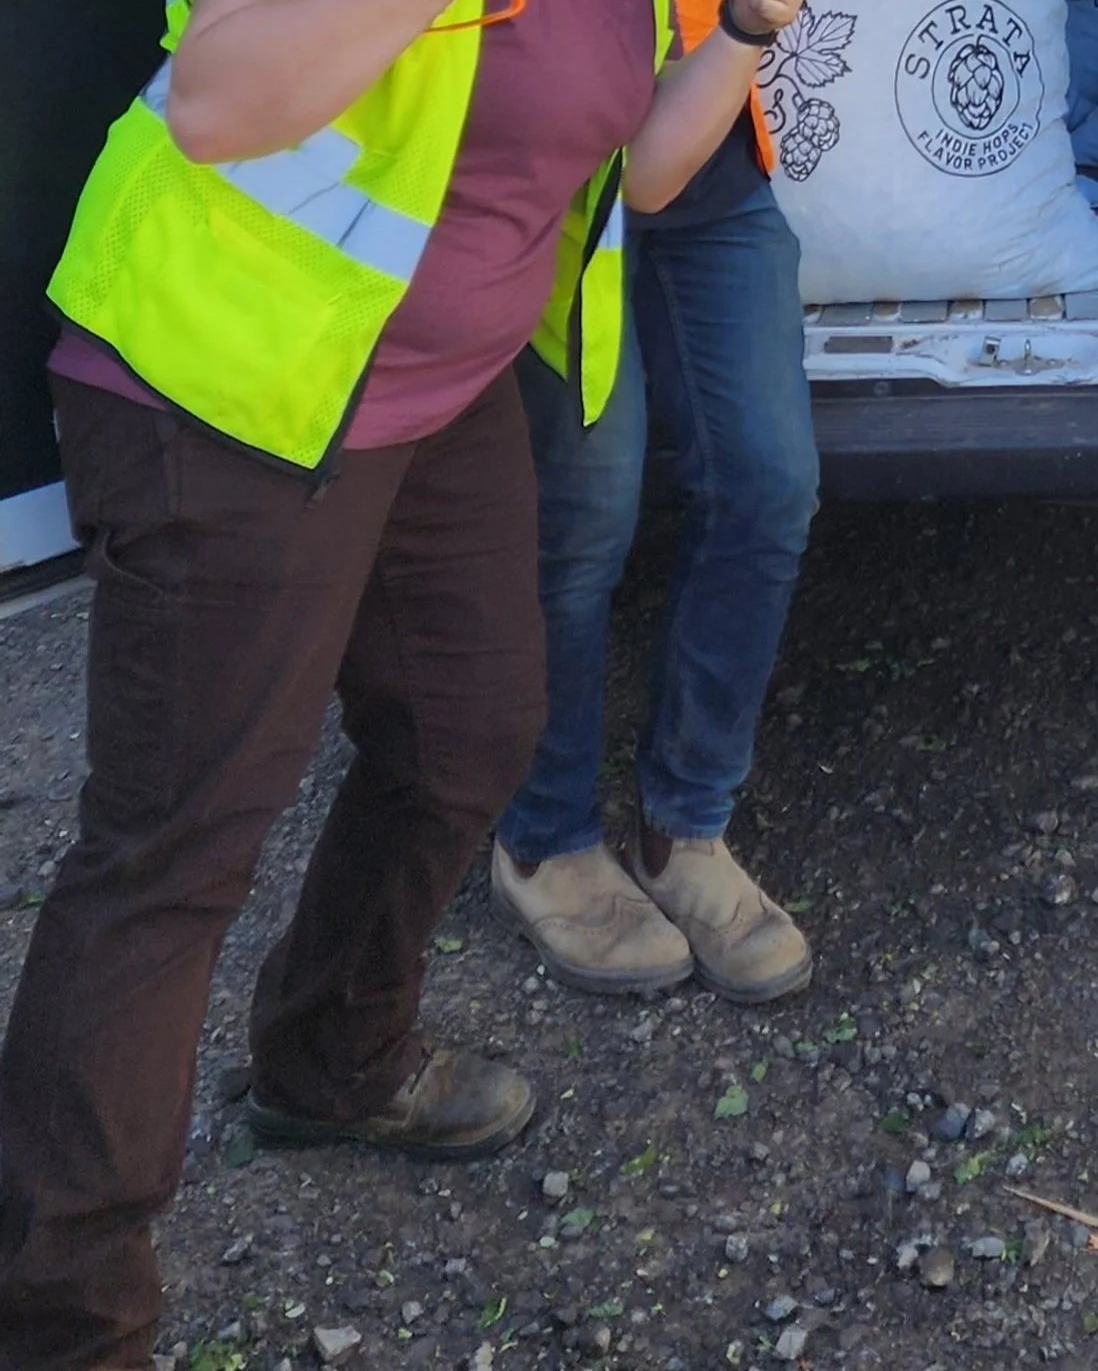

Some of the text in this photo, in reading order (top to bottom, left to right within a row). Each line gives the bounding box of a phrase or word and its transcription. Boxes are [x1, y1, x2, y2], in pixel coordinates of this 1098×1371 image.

[904, 4, 1031, 80] STRATA
[917, 130, 972, 170] FLAVOR
[935, 123, 1018, 157] INDIE HOPS
